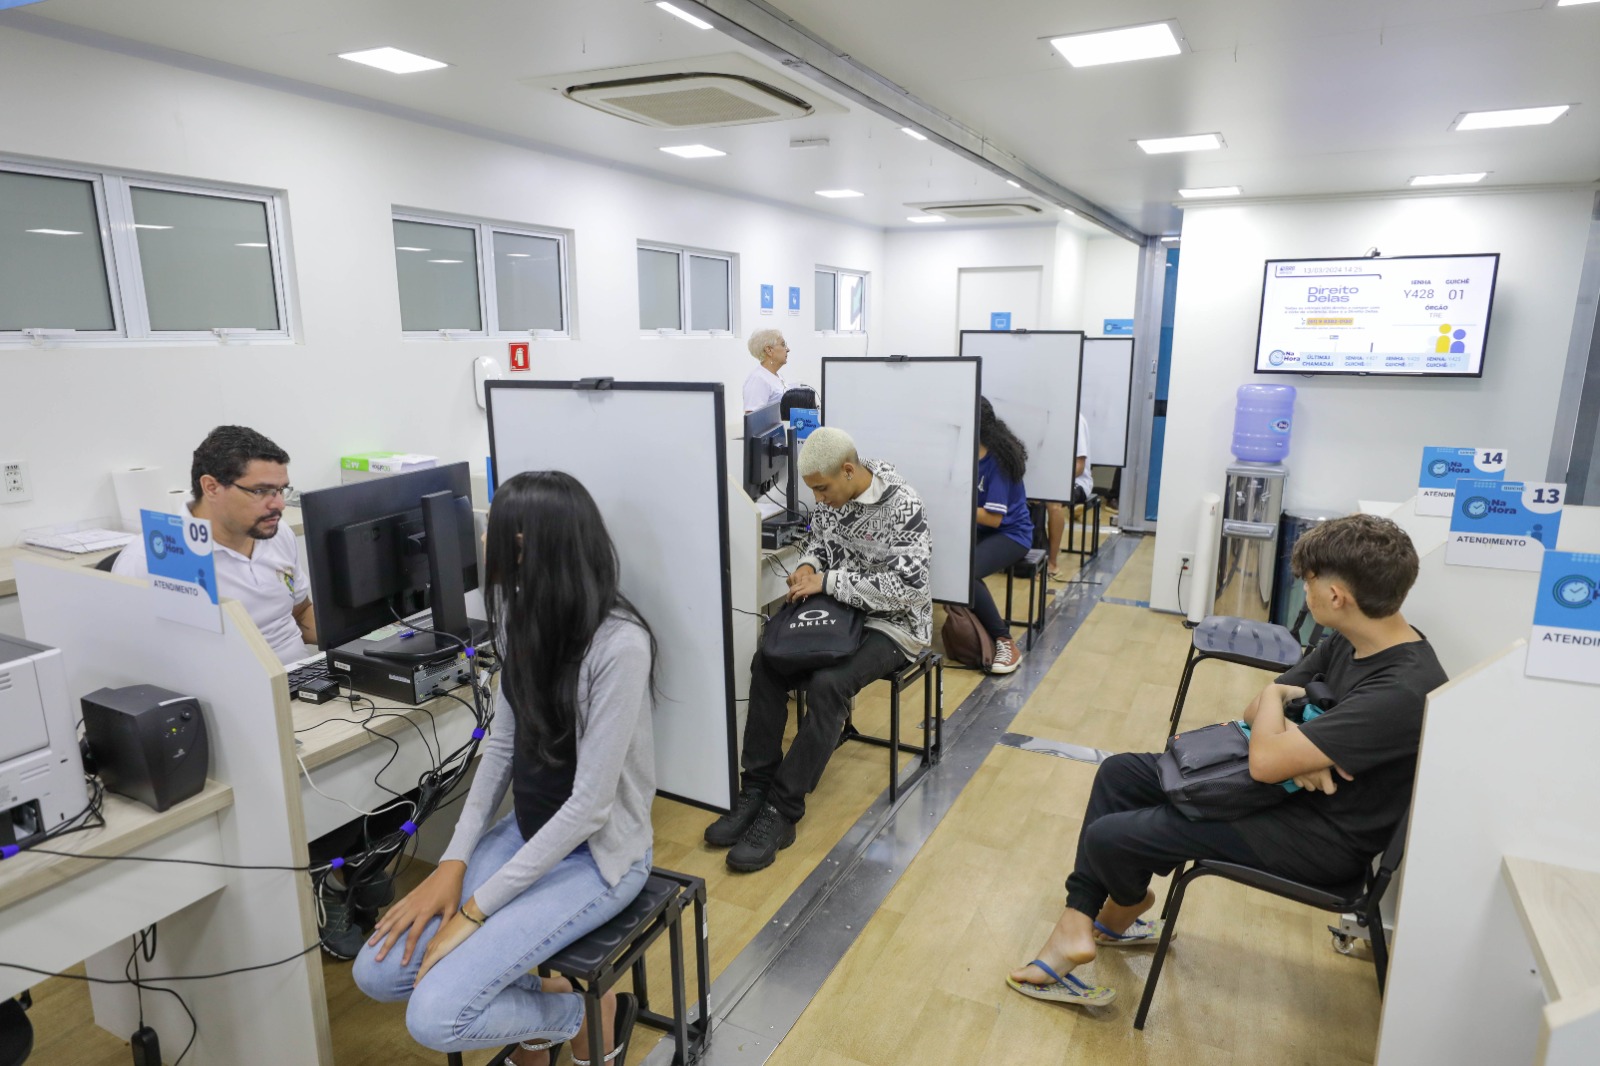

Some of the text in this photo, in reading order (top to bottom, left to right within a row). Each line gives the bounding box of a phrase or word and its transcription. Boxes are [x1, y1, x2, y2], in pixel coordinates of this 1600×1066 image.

[1308, 285, 1359, 294] Direito
[1403, 289, 1435, 299] Y428
[1448, 289, 1464, 300] 01
[1307, 294, 1350, 302] Delas
[1482, 452, 1503, 464] 14
[1532, 488, 1560, 504] 13
[1491, 499, 1507, 507] Na
[1488, 506, 1517, 515] Hora
[190, 522, 208, 544] 09
[165, 534, 176, 544] Na
[1456, 535, 1526, 547] ATENDIMENTO
[165, 544, 184, 555] Hora
[154, 579, 199, 596] ATENDIMENTO
[790, 619, 837, 629] OAKLEY
